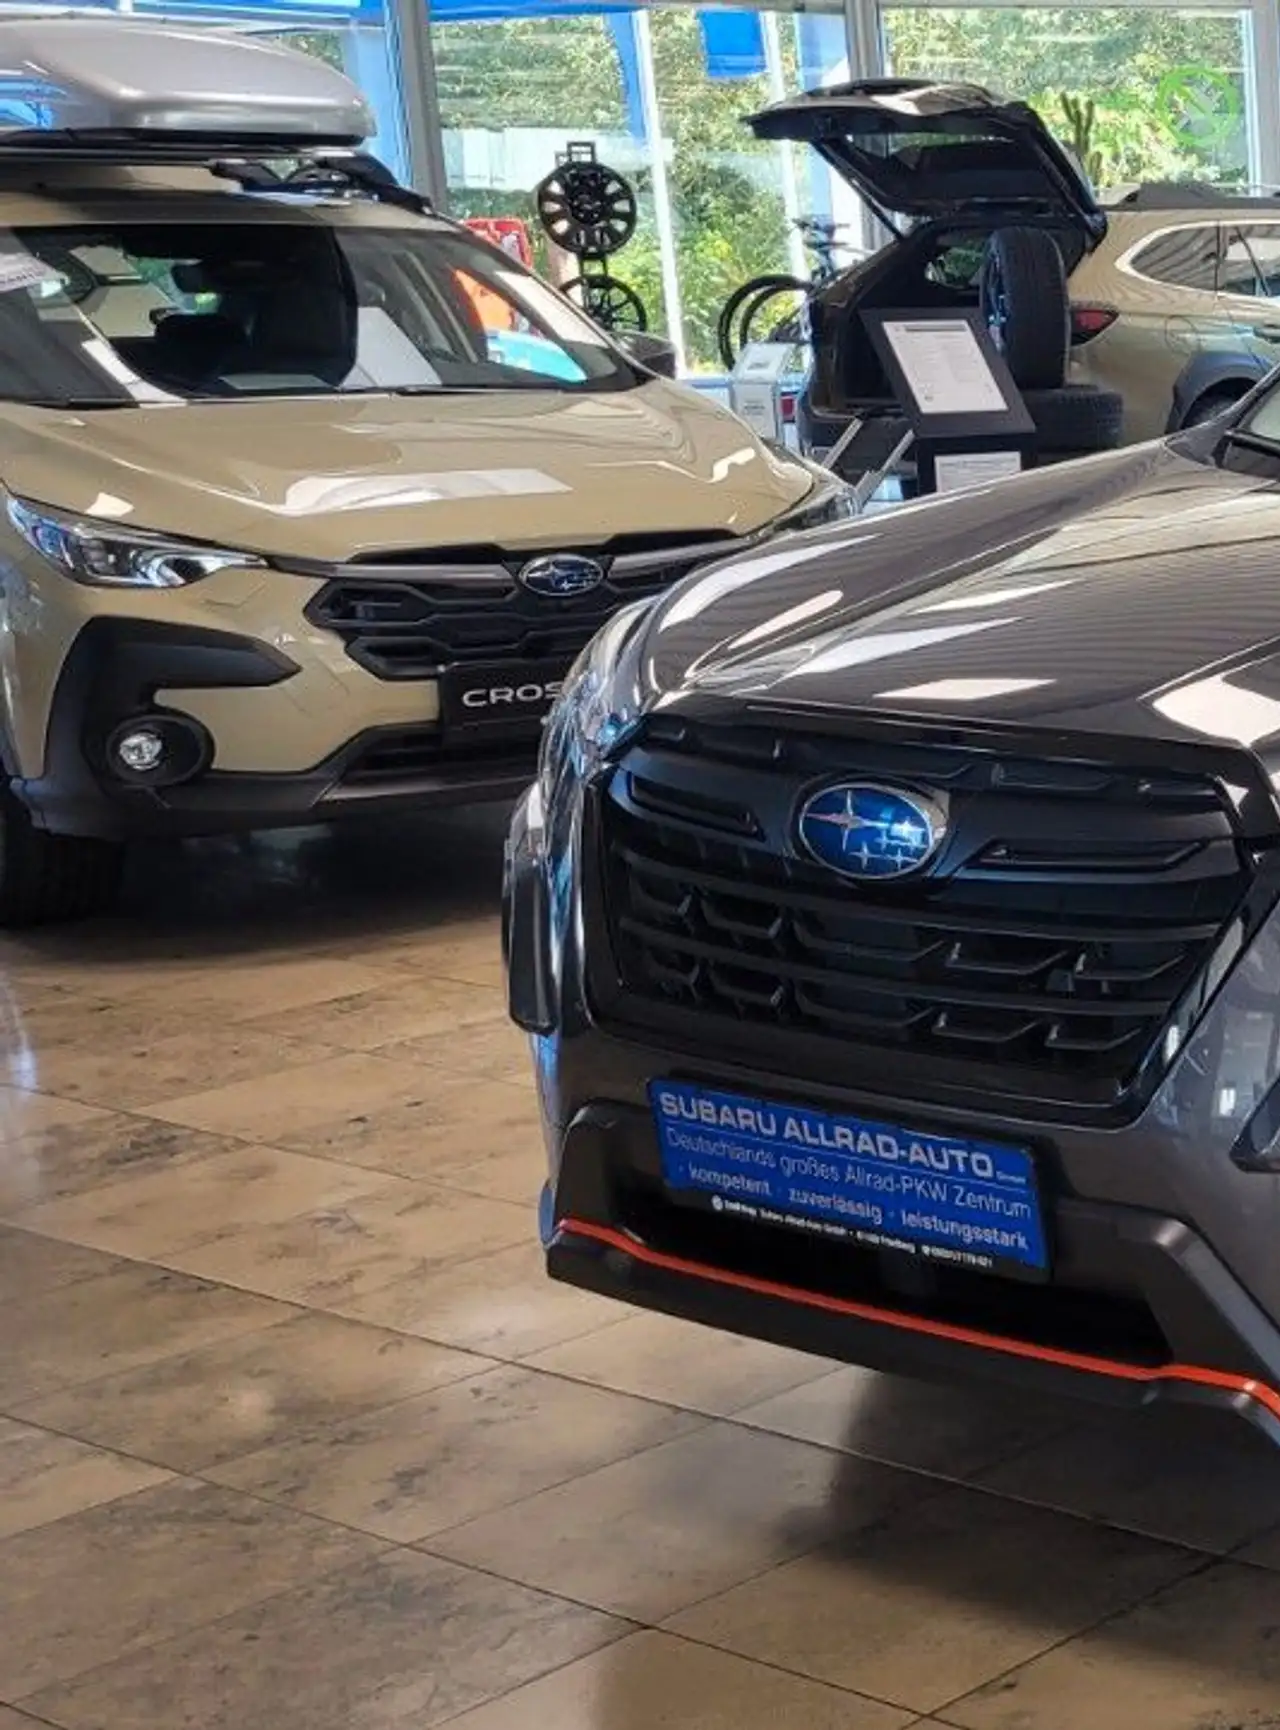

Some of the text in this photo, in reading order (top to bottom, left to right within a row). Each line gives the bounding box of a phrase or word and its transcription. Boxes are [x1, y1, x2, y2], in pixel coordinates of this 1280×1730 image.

[659, 1092, 994, 1179] SUBARU ALLRAD-AUTO
[666, 1126, 1032, 1218] Deutschlands großes Allrad-PKW Zentrum
[688, 1160, 773, 1196] kompetent
[901, 1208, 1030, 1251] leistungsstark
